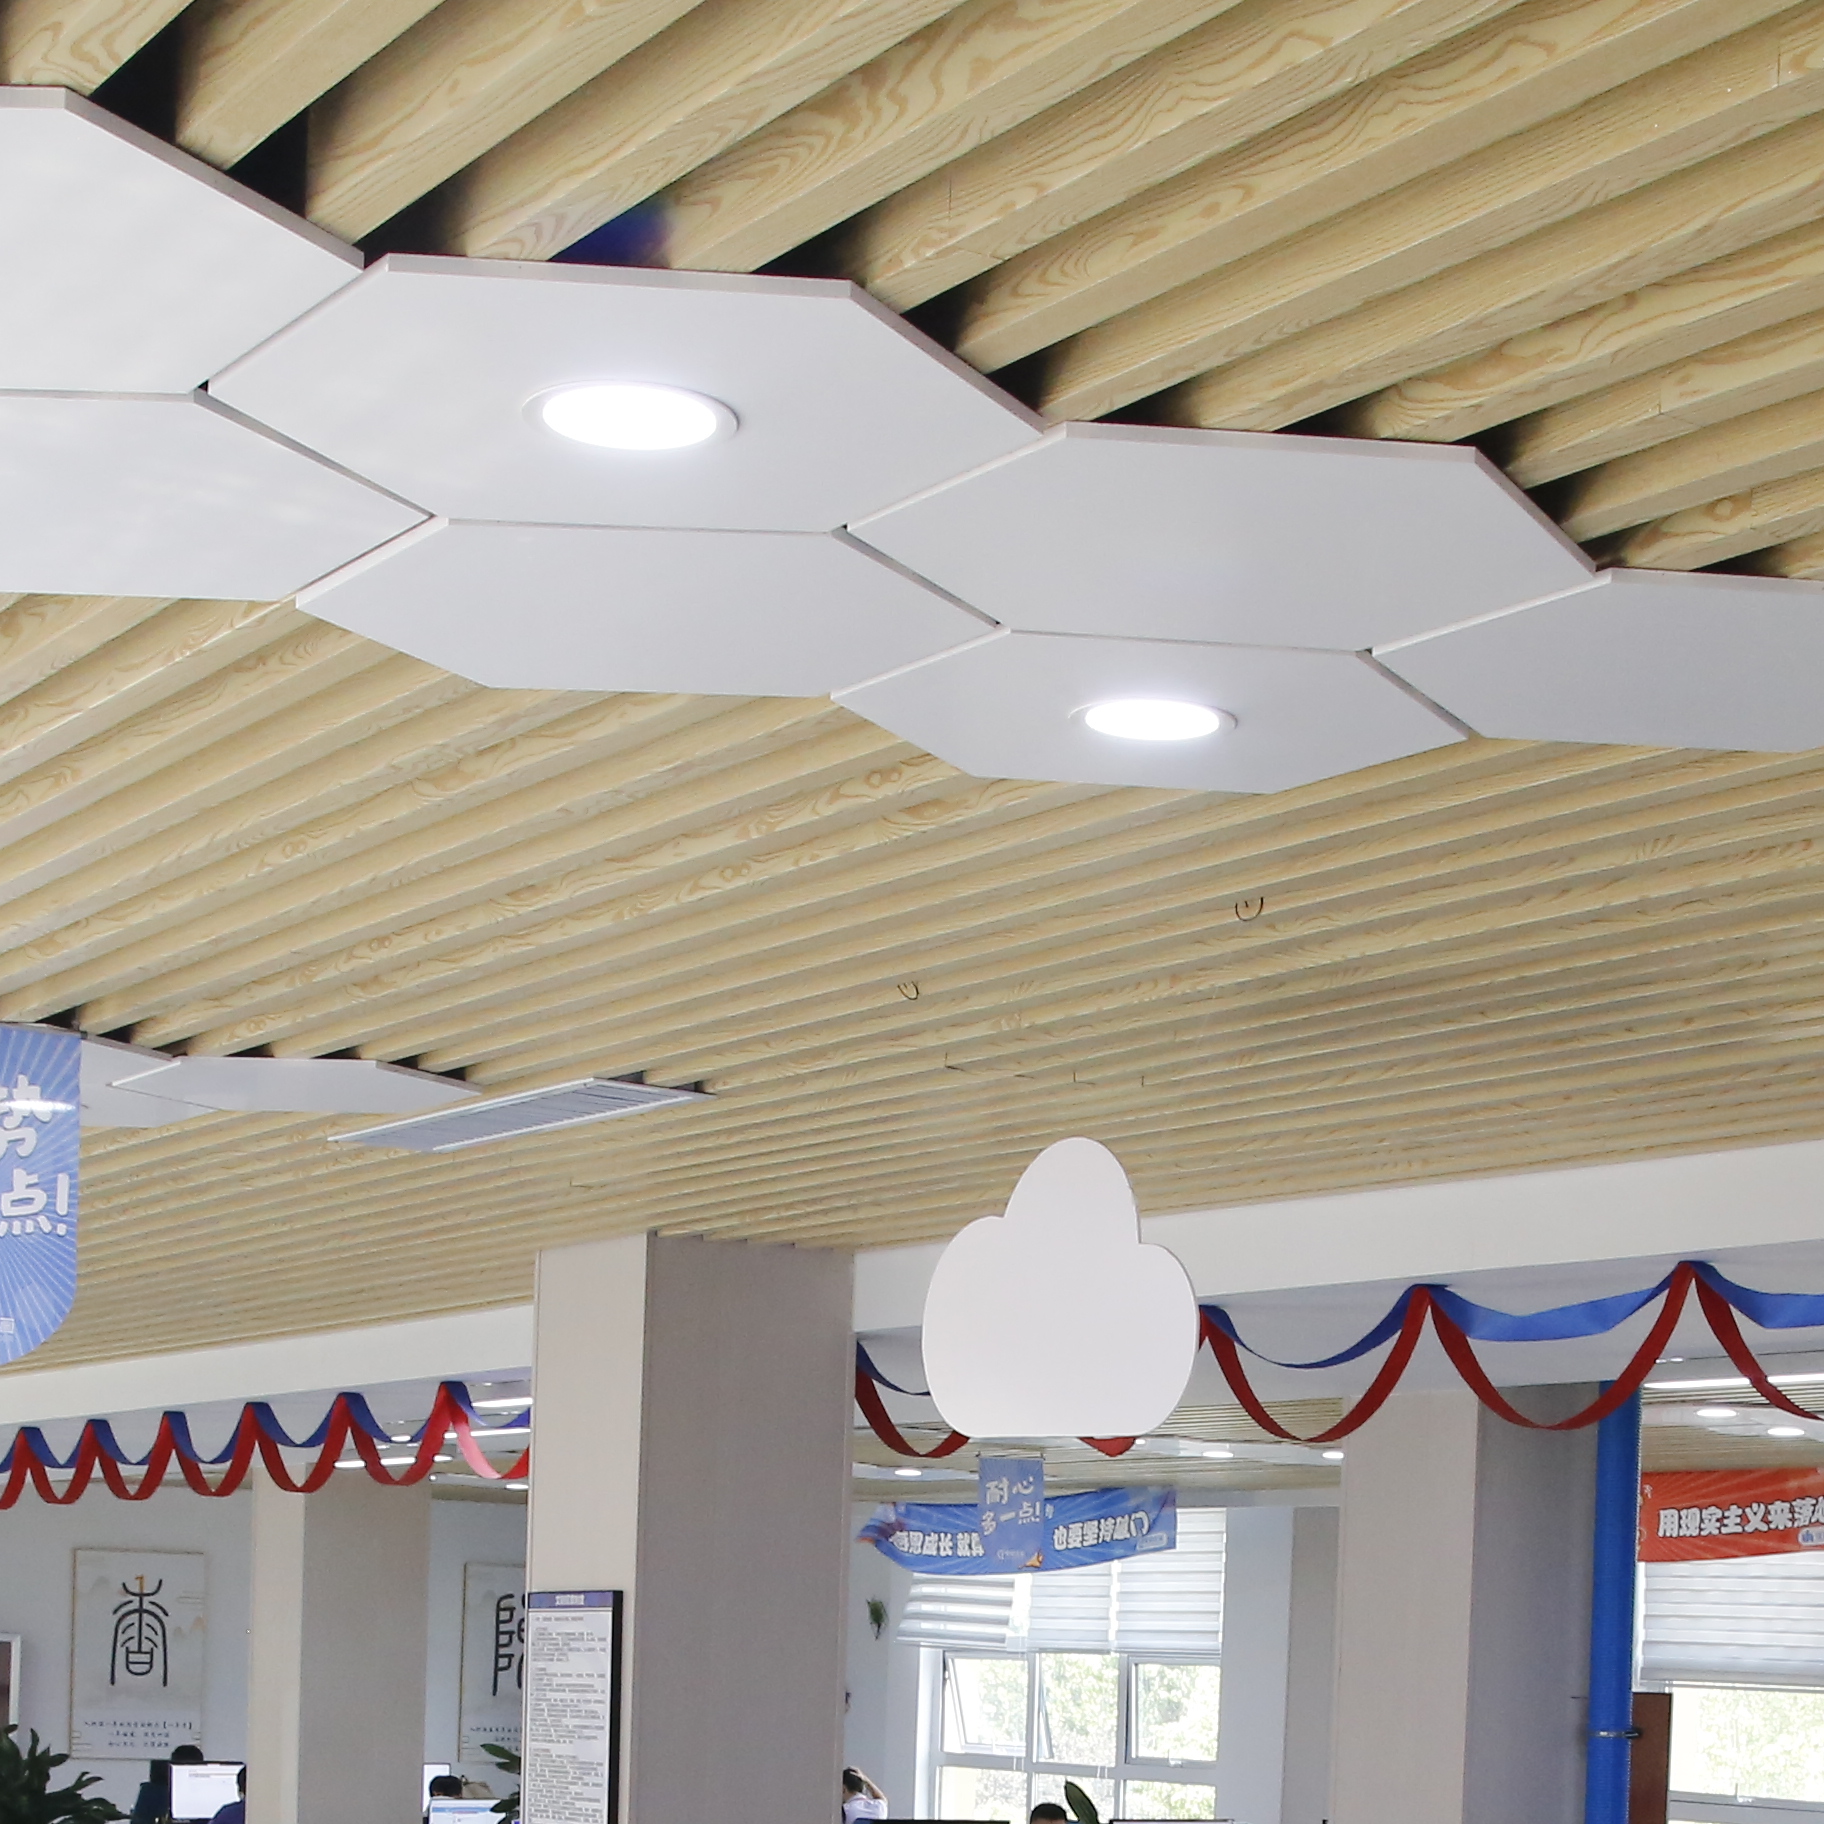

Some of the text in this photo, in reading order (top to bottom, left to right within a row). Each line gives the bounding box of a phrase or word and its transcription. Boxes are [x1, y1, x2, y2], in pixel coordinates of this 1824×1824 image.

[985, 1477, 1034, 1505] 耐心
[981, 1501, 1041, 1536] 多一点!
